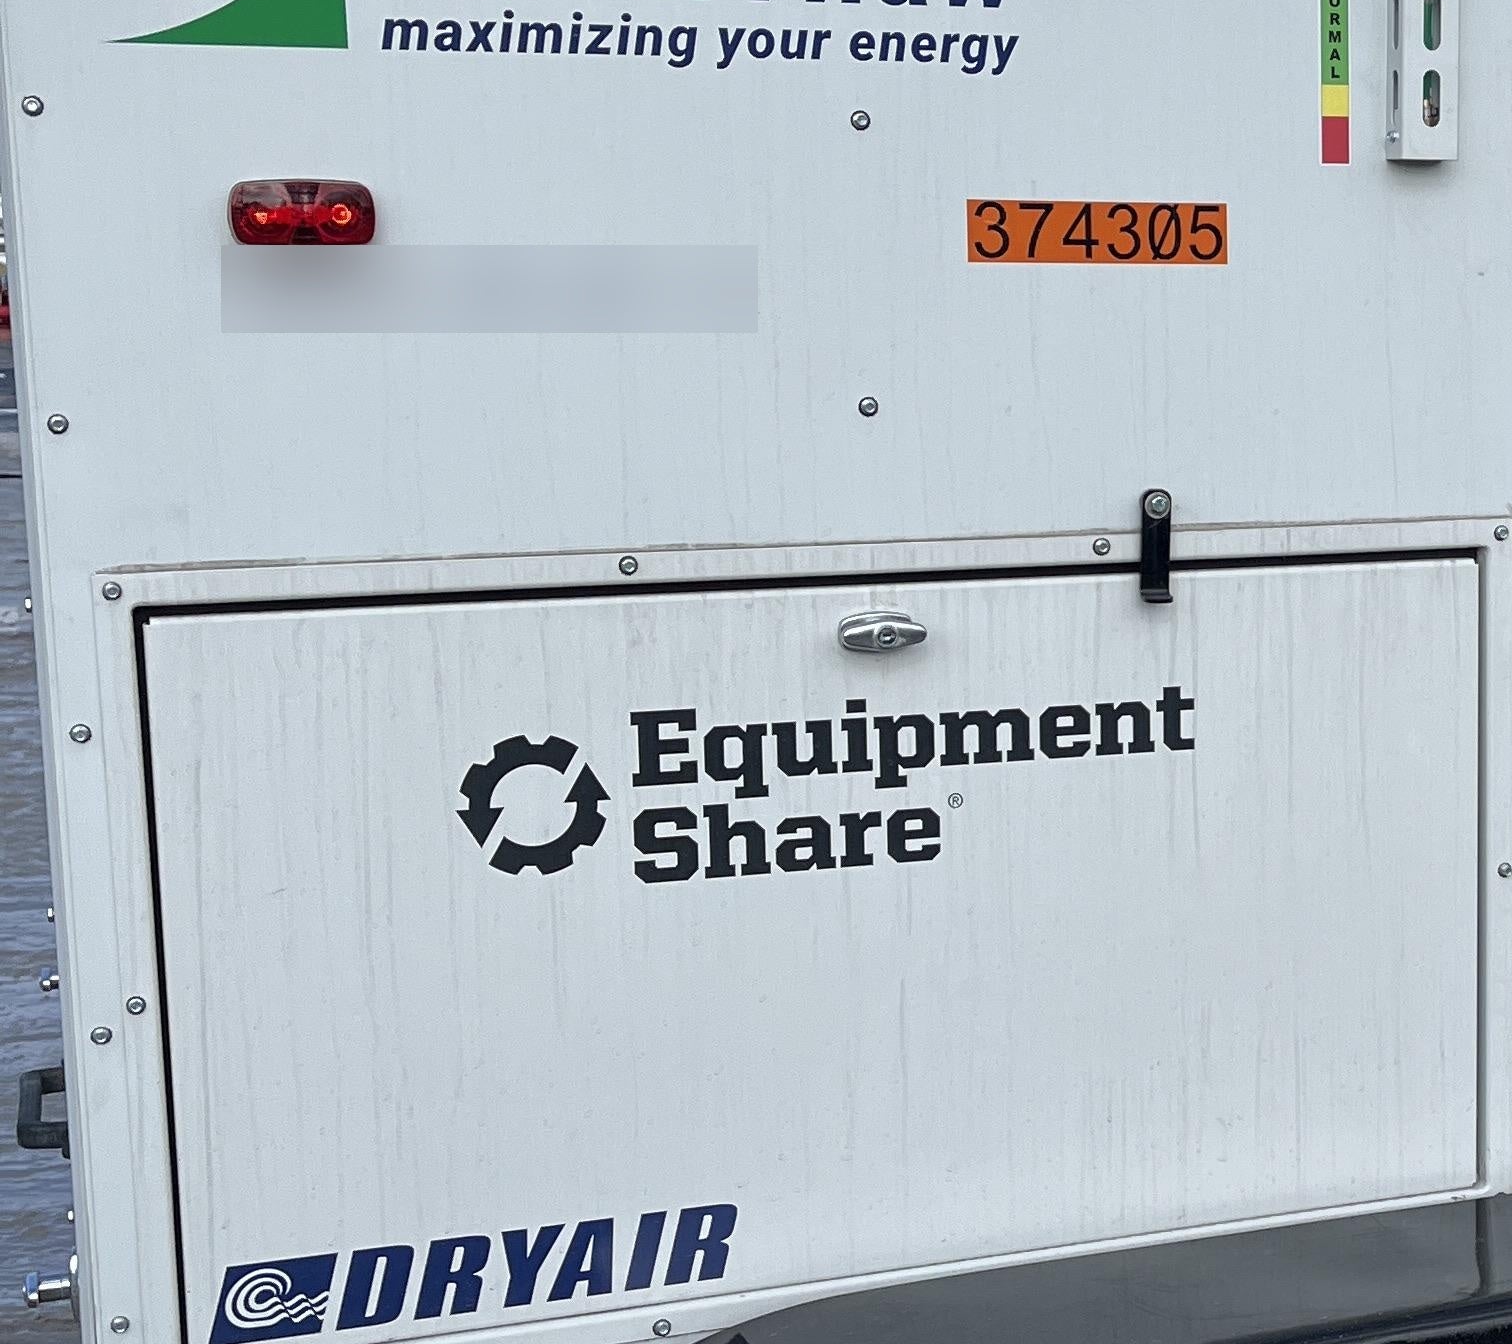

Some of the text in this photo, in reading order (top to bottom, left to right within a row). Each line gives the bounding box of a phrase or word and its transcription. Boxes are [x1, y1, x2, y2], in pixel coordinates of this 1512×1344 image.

[380, 8, 1020, 76] maximizing your energy
[974, 201, 1223, 260] 374305
[630, 686, 1195, 799] Equipment
[633, 804, 941, 884] Share
[335, 1203, 738, 1331] DRYAIR
